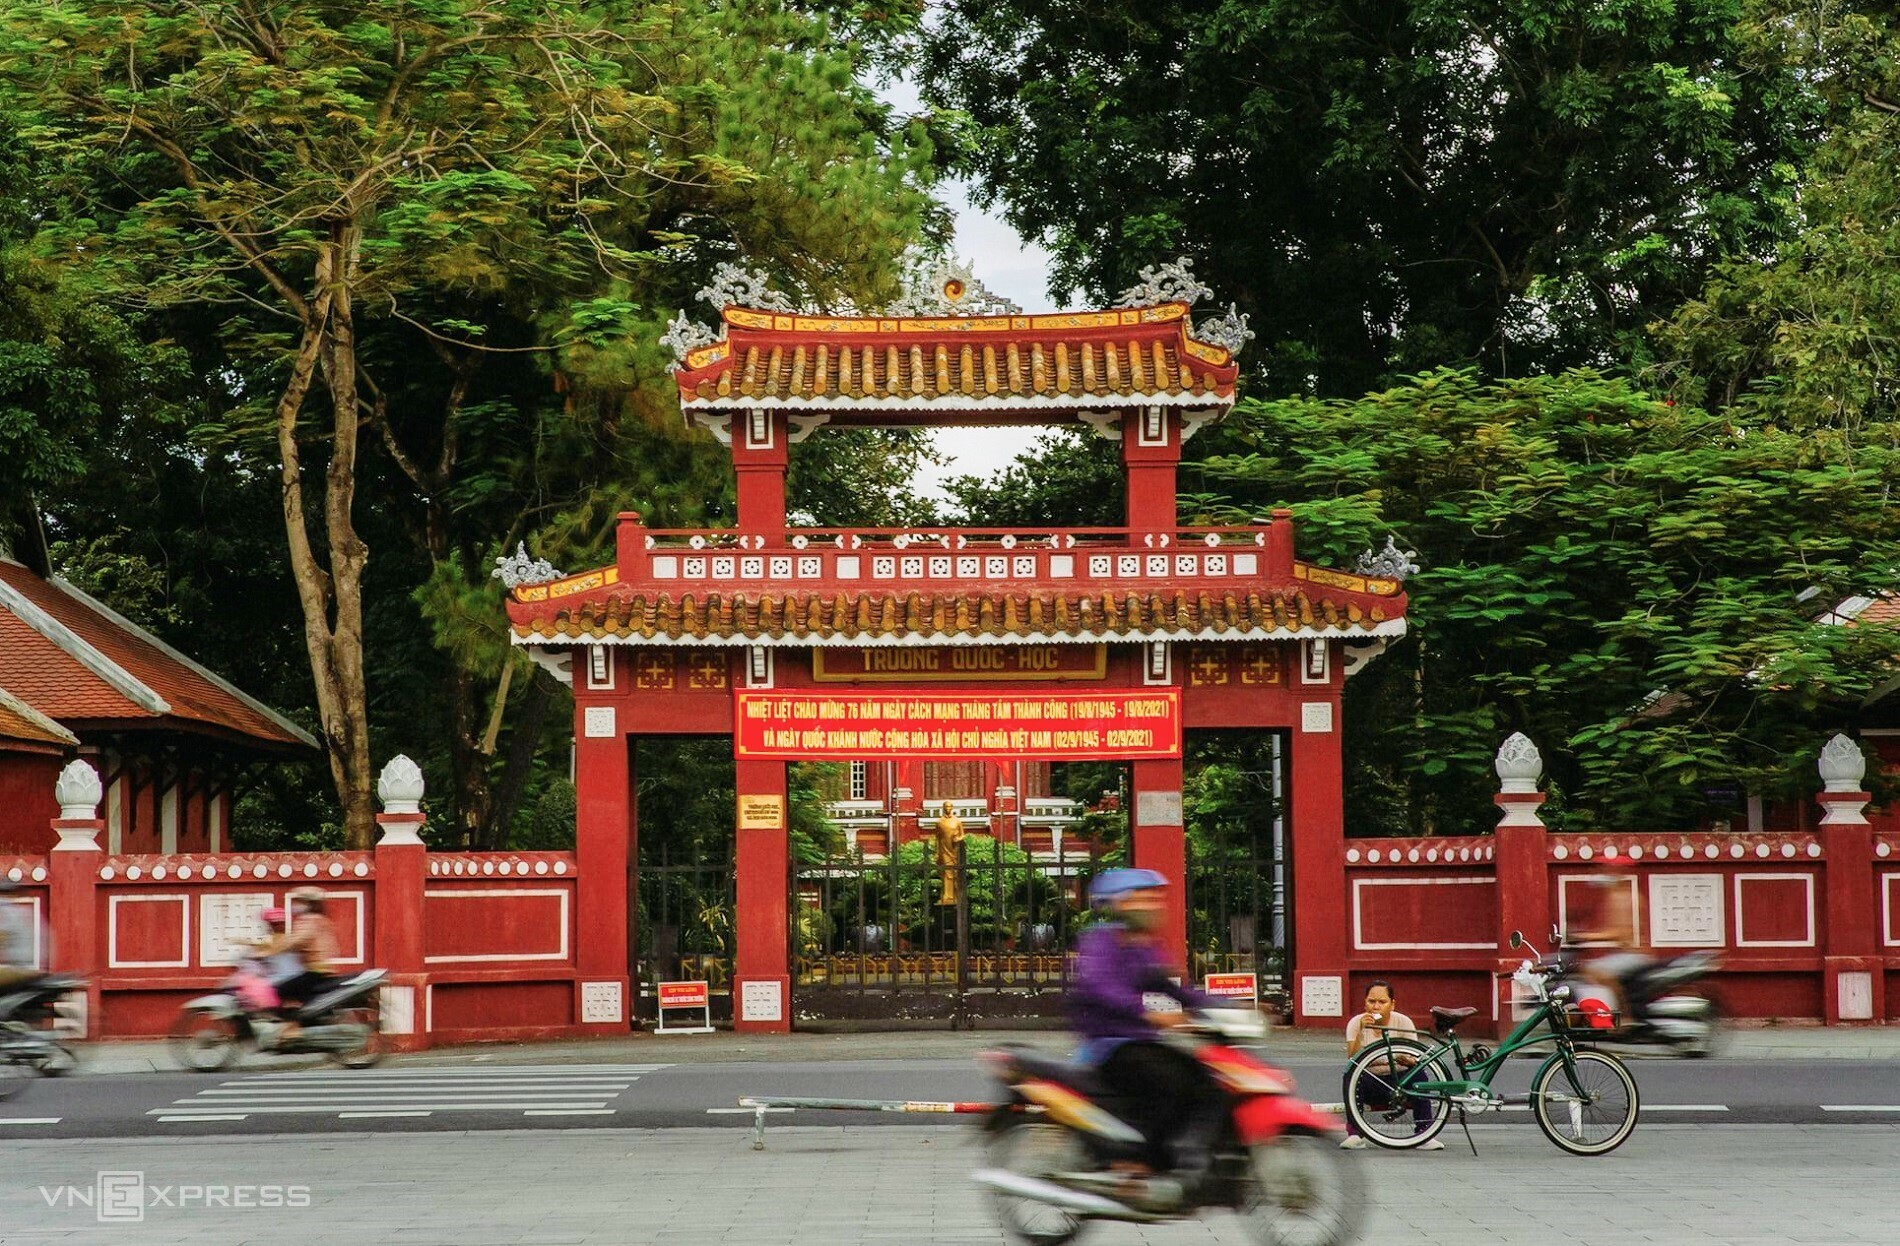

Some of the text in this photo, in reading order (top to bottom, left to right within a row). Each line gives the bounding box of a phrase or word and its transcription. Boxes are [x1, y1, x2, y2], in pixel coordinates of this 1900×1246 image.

[1018, 648, 1058, 671] HỌC
[747, 698, 772, 722] NHIỆT
[774, 698, 792, 722] LIỆT
[794, 699, 817, 719] CHÀO
[819, 698, 845, 719] MỪNG
[848, 702, 858, 719] 76
[860, 697, 881, 719] NĂM
[882, 699, 906, 719] NGÀY
[908, 699, 932, 719] CÁCH
[934, 702, 960, 723] MẠNG
[962, 699, 990, 719] THÁNG
[993, 699, 1011, 719] TÁM
[1013, 699, 1042, 719] THÀNH
[1044, 699, 1068, 719] CÔNG
[1070, 701, 1115, 720] (19/8/1945
[1124, 700, 1169, 719] 19/8/2021)
[763, 727, 776, 747] VÀ
[777, 727, 800, 747] NGÀY
[802, 725, 826, 749] QUỐC
[828, 728, 857, 748] KHÁNH
[859, 728, 884, 748] NƯỚC
[885, 728, 909, 752] CỘNG
[911, 727, 929, 748] HÒA
[931, 728, 943, 748] XÃ
[945, 728, 960, 752] HỘI
[962, 726, 980, 748] CHỦ
[981, 728, 1008, 748] NGHĨA
[1010, 728, 1029, 752] VIỆT
[1031, 731, 1051, 748] NAM
[1054, 731, 1099, 749] (02/9/1945
[1107, 730, 1153, 748] 02/9/2021)
